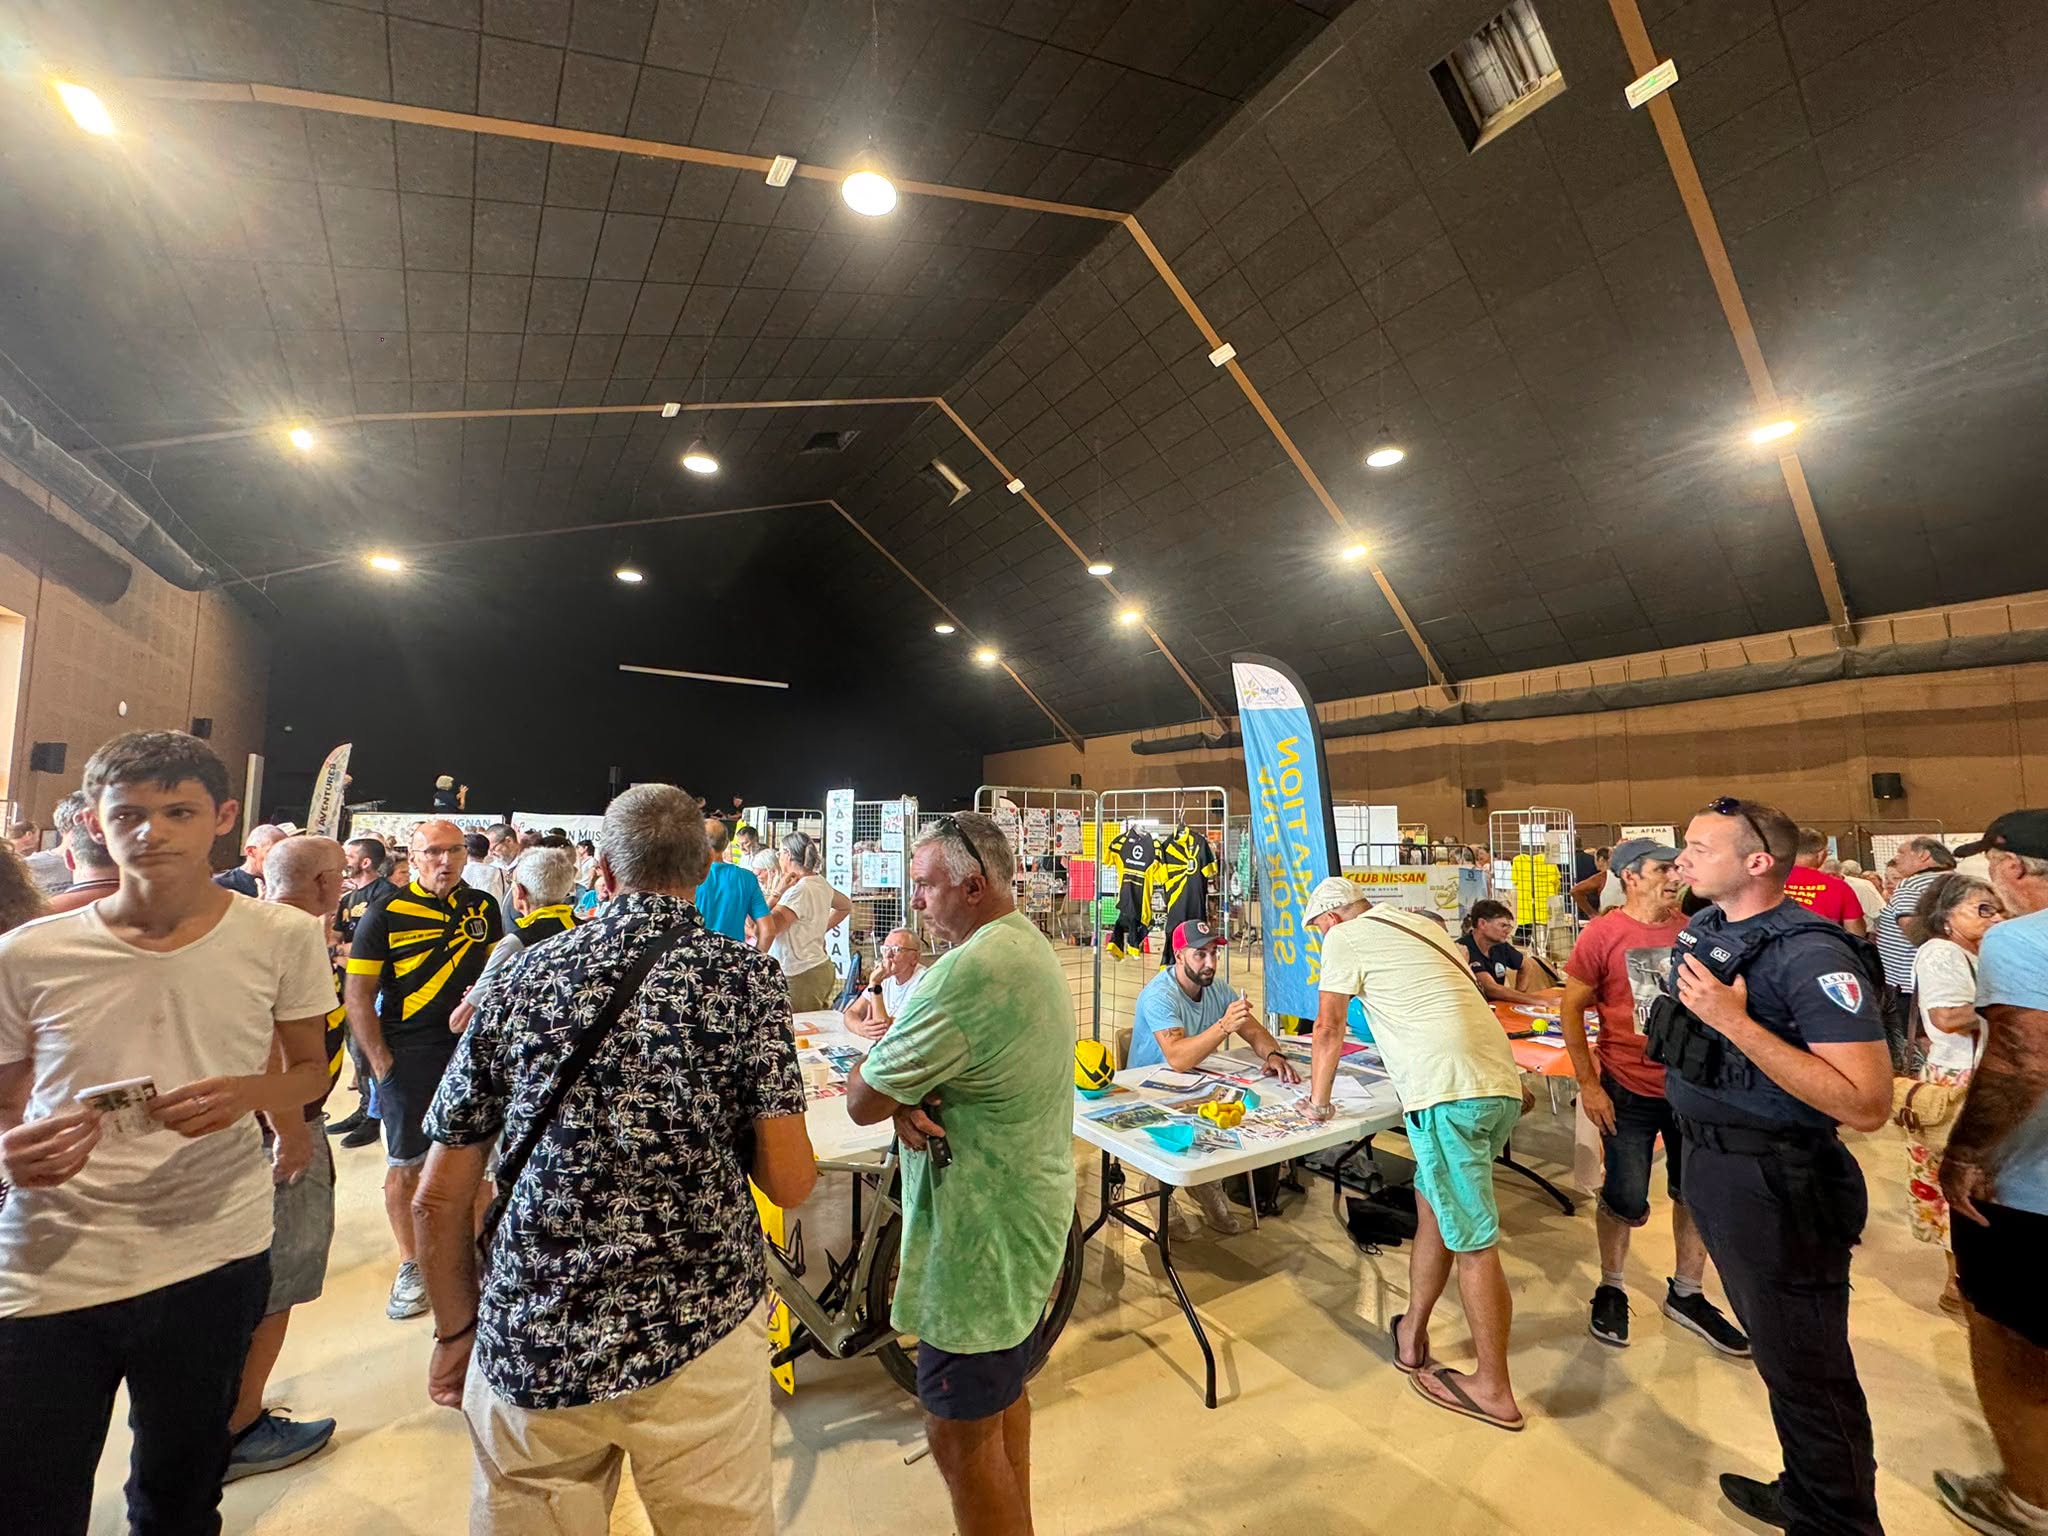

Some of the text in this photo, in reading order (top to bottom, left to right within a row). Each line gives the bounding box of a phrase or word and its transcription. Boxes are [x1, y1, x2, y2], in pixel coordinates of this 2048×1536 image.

[319, 763, 337, 826] AVENTURES
[1347, 872, 1426, 883] CLUB NISSAN
[1678, 930, 1698, 944] ASVP
